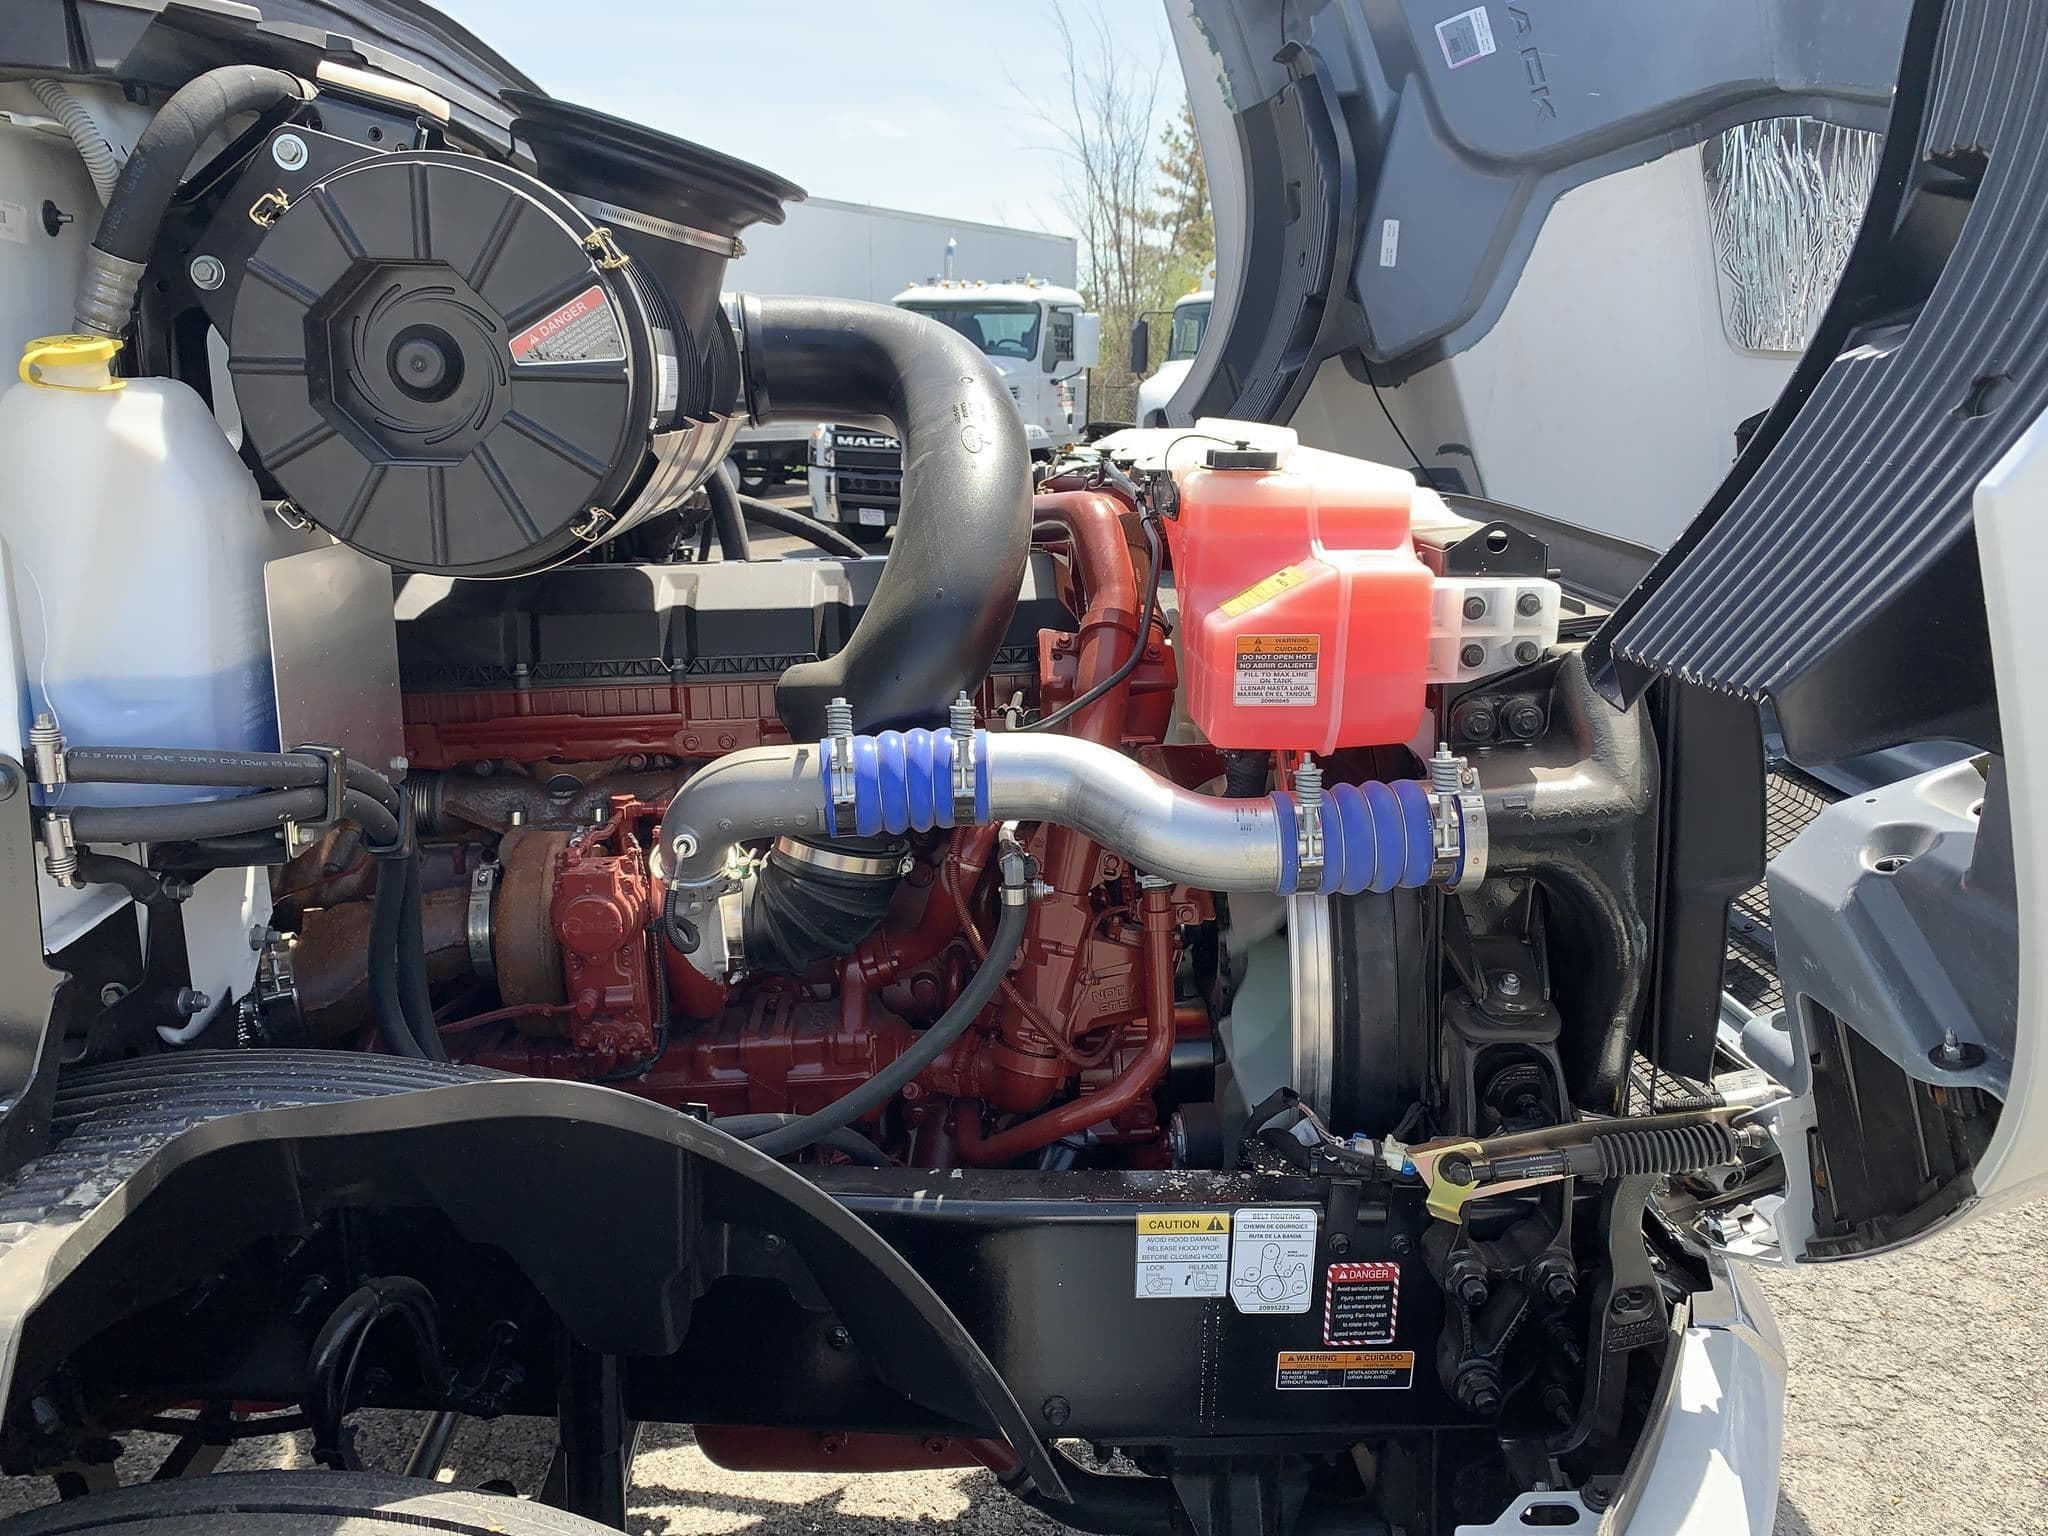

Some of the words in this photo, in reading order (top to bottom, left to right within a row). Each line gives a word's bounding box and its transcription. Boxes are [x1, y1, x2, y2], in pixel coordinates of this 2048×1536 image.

[1507, 0, 1556, 119] ACK
[539, 302, 587, 336] DANGER
[837, 436, 900, 448] MACK
[1091, 984, 1125, 1003] NOT
[1149, 1220, 1200, 1230] CAUTION
[1350, 1270, 1388, 1279] DANGER
